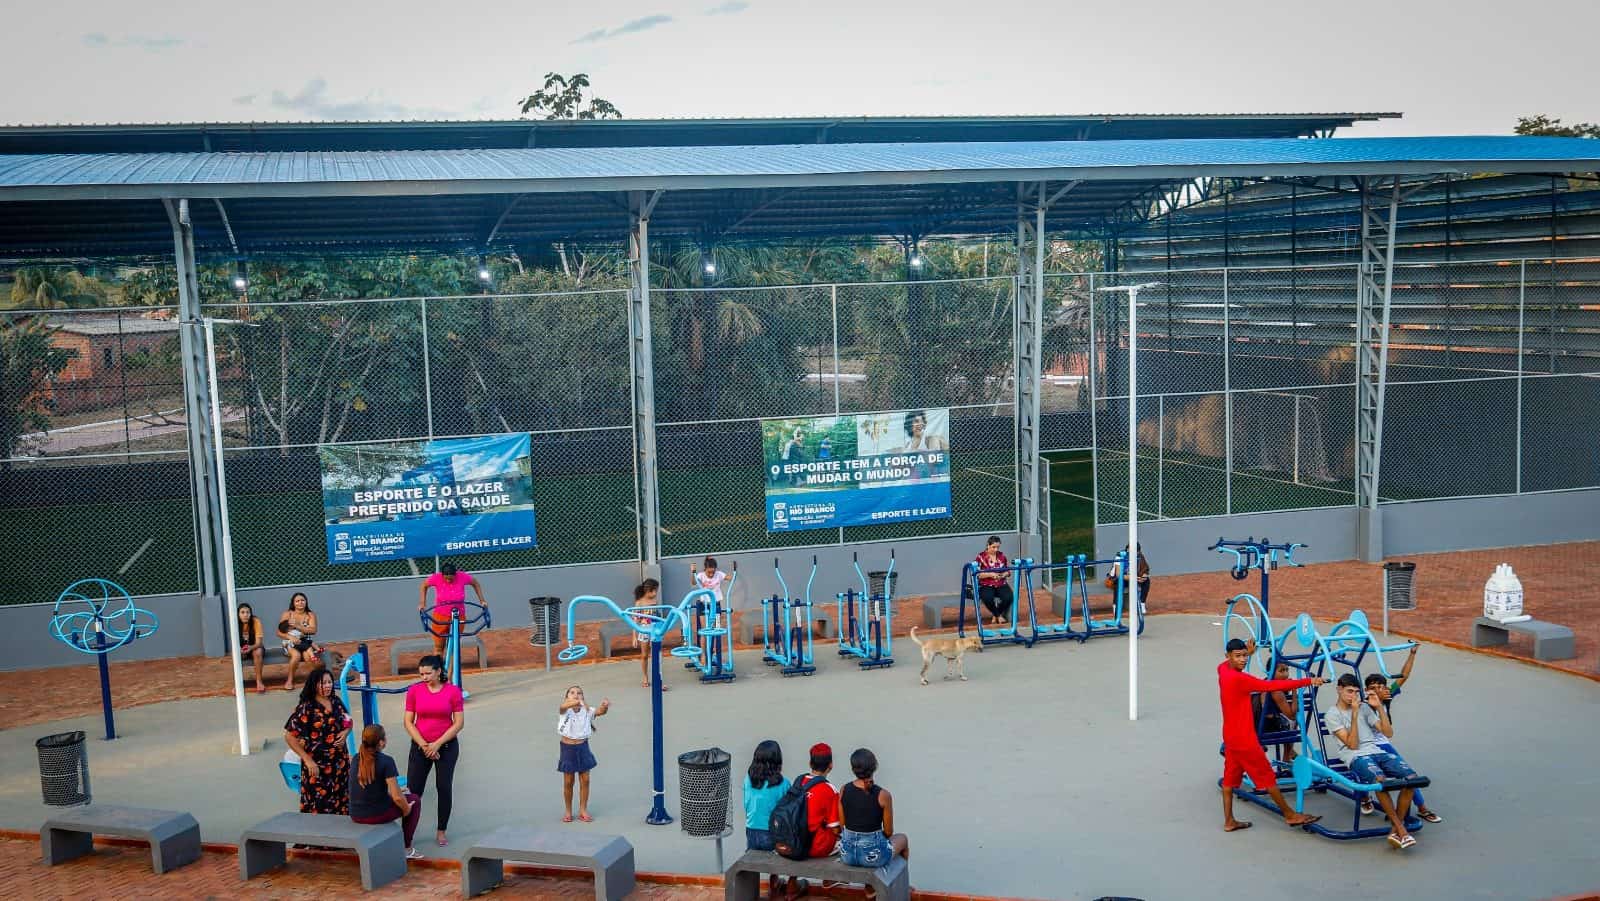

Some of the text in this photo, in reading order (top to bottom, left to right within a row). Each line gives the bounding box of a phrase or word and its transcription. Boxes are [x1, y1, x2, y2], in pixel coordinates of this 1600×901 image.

[771, 453, 944, 475] O ESPORTE TEM A FORÇA DE
[806, 467, 911, 484] MUDAR O MUNDO
[354, 481, 504, 503] ESPORTE É O LAZER
[349, 493, 511, 517] PREFERIDO DA SAÚDE
[805, 506, 835, 514] BRANCO
[871, 509, 911, 519] ESPORTE
[920, 506, 947, 516] LAZER
[370, 536, 405, 545] BRANCO
[446, 535, 532, 551] ESPORTE E LAZER
